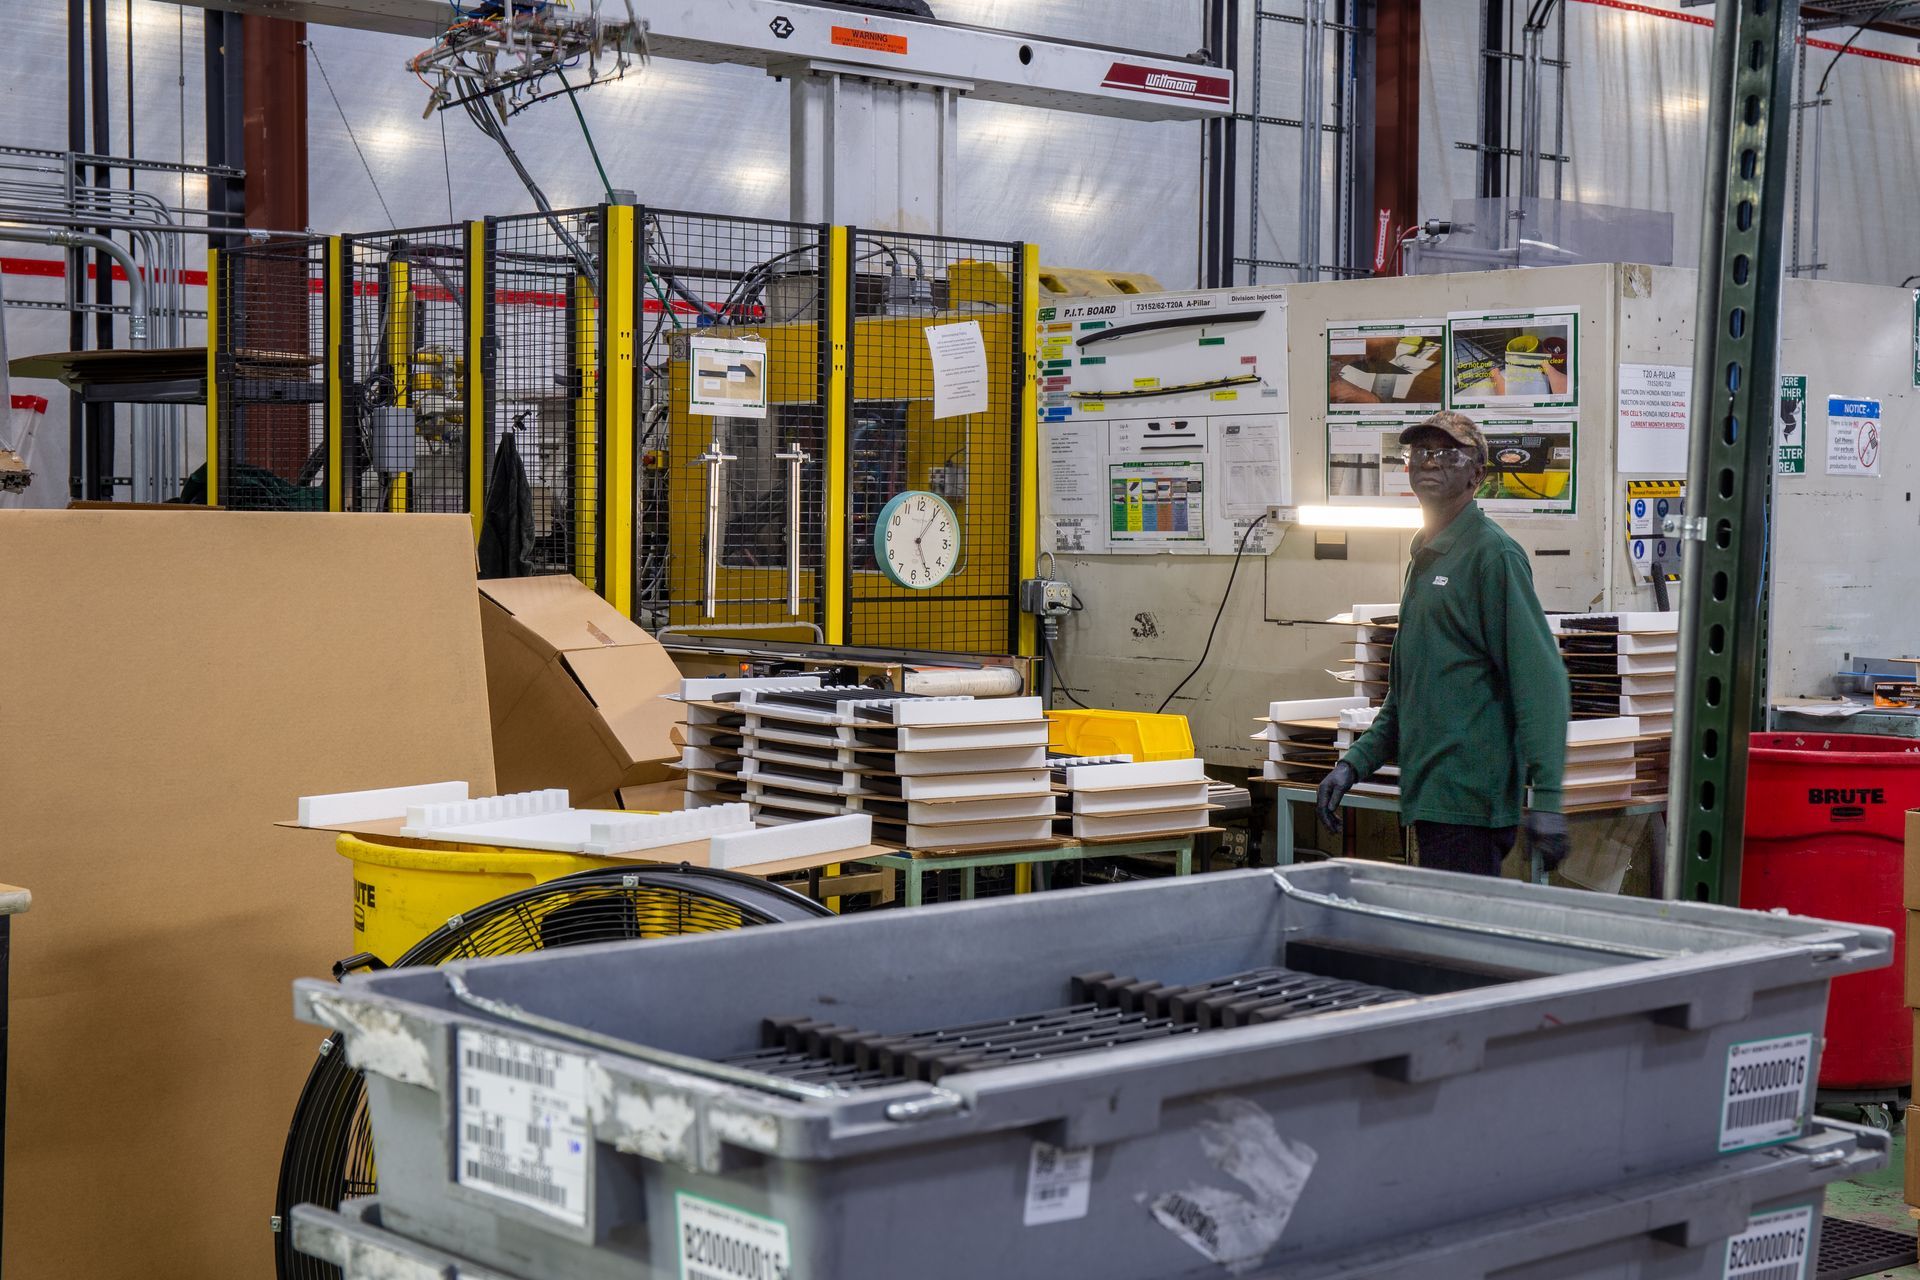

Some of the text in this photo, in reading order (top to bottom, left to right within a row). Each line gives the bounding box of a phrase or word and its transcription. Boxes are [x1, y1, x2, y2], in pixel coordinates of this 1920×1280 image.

[851, 29, 888, 42] WARNING
[1145, 73, 1198, 92] Wittmann
[1256, 293, 1283, 301] Injection
[1186, 299, 1210, 308] A-Pillar
[1087, 305, 1116, 316] BOARD
[1653, 370, 1676, 379] A-PILLAR
[1844, 403, 1867, 414] NOTICE
[904, 504, 911, 515] 11
[917, 501, 926, 511] 12
[892, 515, 901, 526] 10
[940, 522, 946, 532] 2
[886, 531, 892, 541] 9
[942, 539, 948, 550] 3
[888, 550, 894, 560] 8
[936, 556, 942, 566] 4
[898, 562, 904, 573] 7
[924, 568, 930, 578] 5
[910, 570, 916, 580] 6
[1808, 788, 1884, 804] BRUTE
[1729, 1055, 1806, 1097] B200000016
[1729, 1227, 1806, 1270] B200000016
